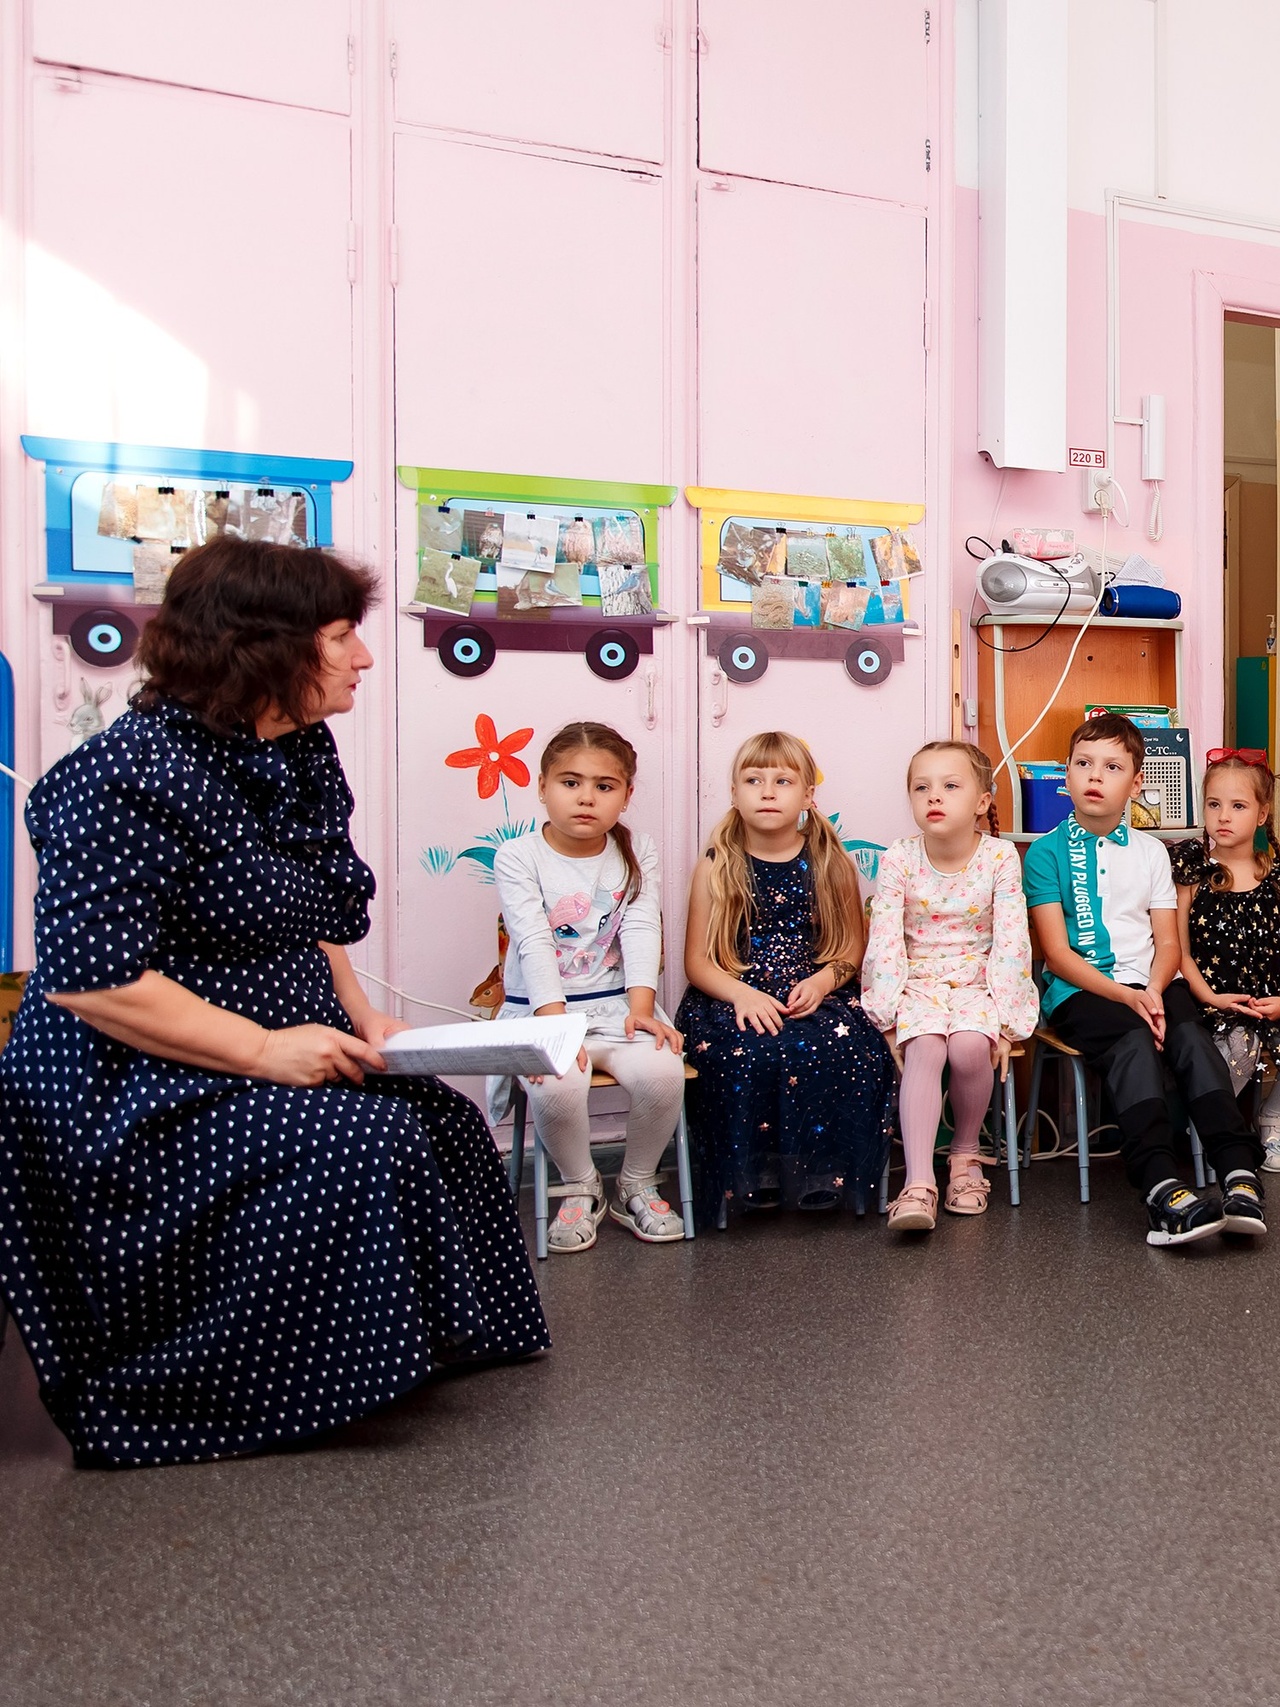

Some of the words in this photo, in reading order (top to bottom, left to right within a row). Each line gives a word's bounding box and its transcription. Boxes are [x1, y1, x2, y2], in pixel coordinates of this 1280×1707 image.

[1072, 452, 1092, 463] 220
[1068, 840, 1087, 870] STAY
[1072, 871, 1094, 929] PLUGGED
[1078, 932, 1096, 946] IN
